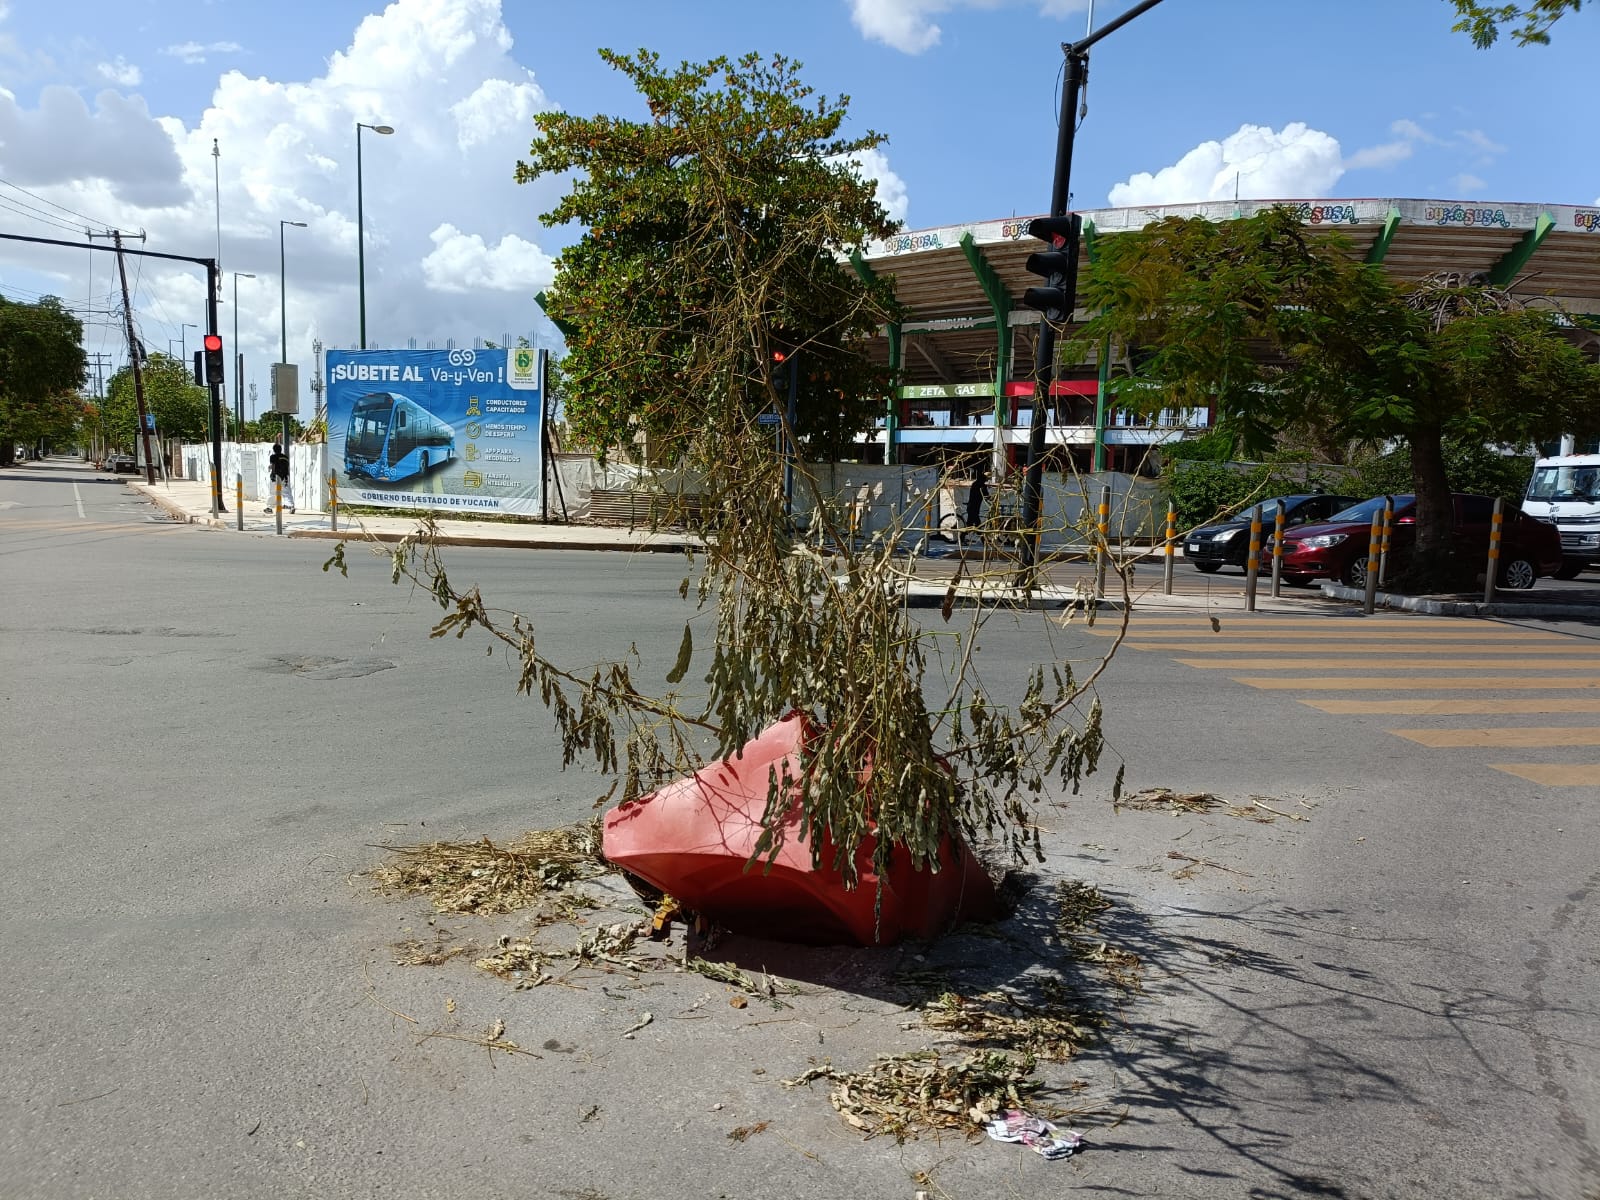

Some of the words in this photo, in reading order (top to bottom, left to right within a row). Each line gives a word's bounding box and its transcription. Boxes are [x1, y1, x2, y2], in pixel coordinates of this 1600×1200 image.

[331, 361, 400, 384] ¡SÚBETE
[402, 365, 423, 382] AL
[431, 367, 494, 386] Va-y-Ven
[920, 387, 946, 396] ZETA
[954, 385, 976, 395] GAS
[361, 492, 399, 501] GOBIERNO
[401, 495, 416, 503] DEL
[417, 496, 447, 505] ESTADO
[462, 497, 499, 508] YUCATÁN
